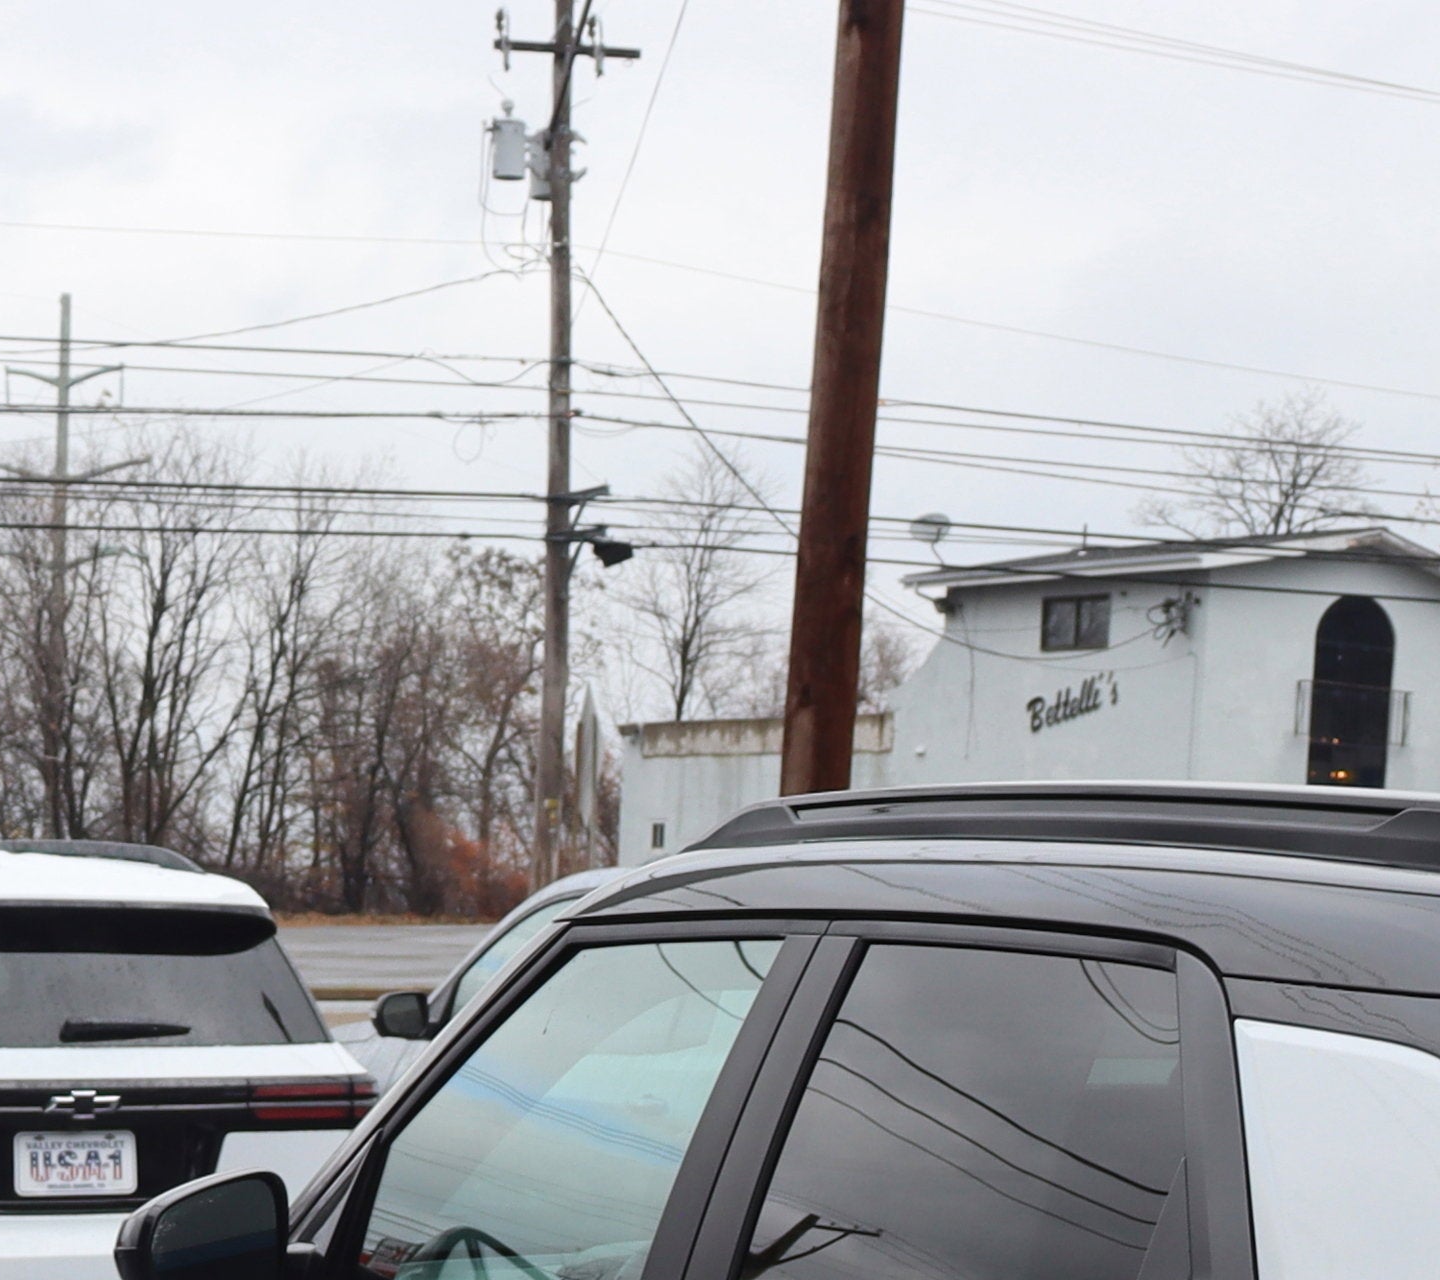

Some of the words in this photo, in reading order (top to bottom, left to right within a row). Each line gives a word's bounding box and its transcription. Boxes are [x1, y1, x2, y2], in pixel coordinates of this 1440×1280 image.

[1026, 669, 1119, 733] Bettelli's
[25, 1140, 62, 1150] VALLEY
[64, 1139, 125, 1150] CHEVROLET
